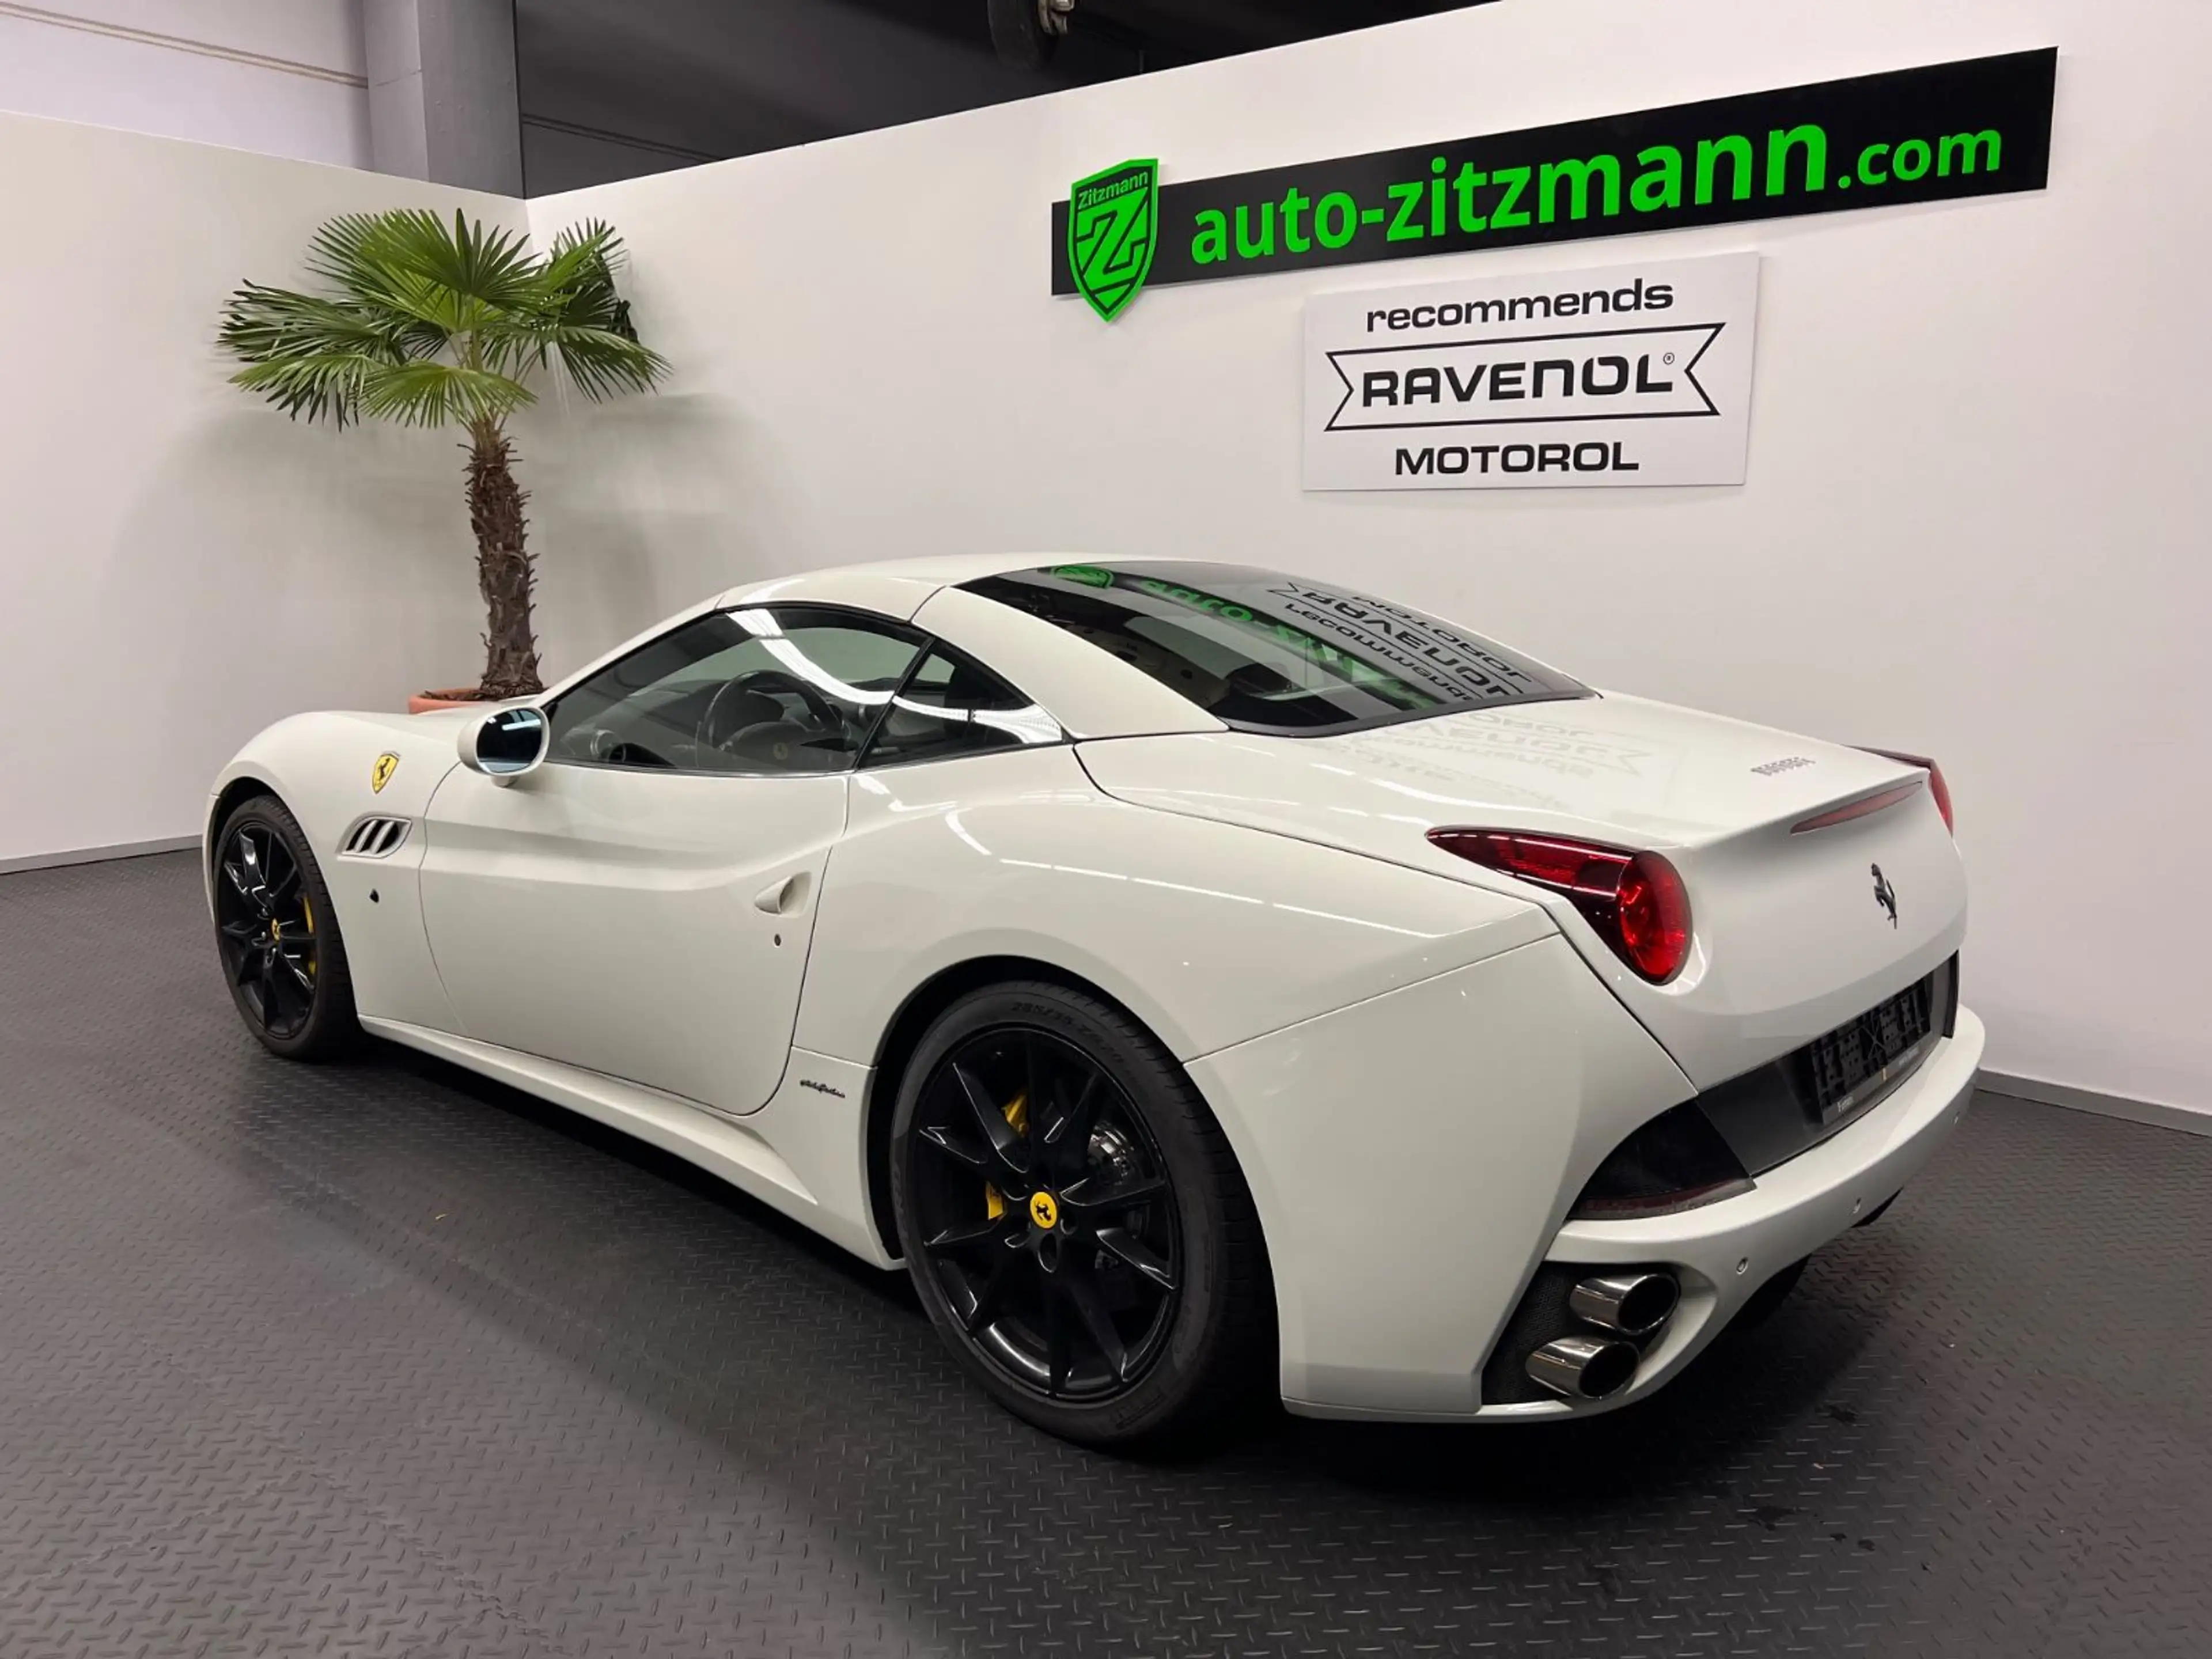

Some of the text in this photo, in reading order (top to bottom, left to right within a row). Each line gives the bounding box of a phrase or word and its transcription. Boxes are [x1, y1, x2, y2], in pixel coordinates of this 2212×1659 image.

[1078, 172, 1149, 210] Zitzmann
[1191, 124, 2002, 264] auto-zitzmann.com
[1367, 278, 1674, 332] recommends
[1395, 442, 1639, 475] MOTOROL
